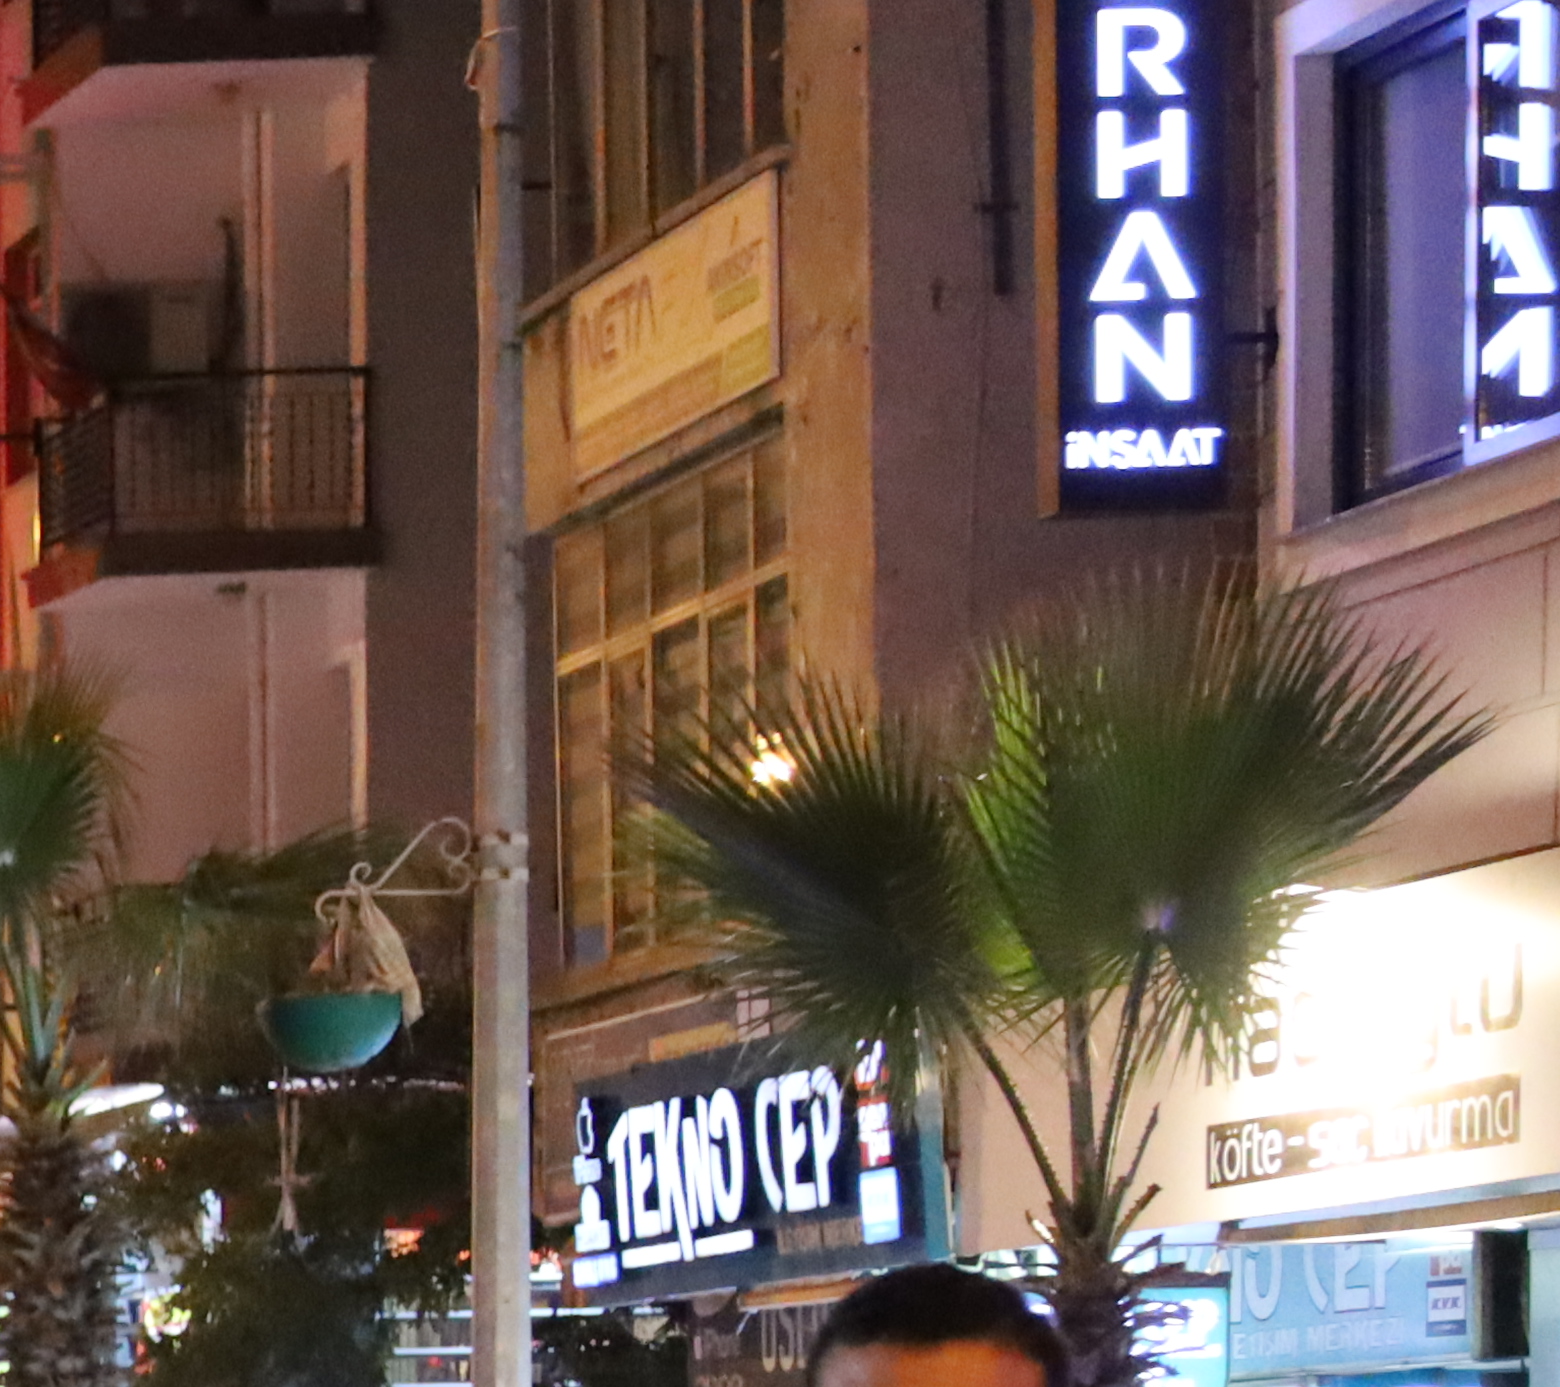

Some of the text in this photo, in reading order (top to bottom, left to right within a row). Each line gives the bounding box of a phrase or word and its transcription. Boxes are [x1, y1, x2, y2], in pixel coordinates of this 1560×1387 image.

[1089, 7, 1198, 402] RHAN
[606, 1064, 843, 1262] TEKNO CEP
[1208, 1122, 1284, 1184] köfte
